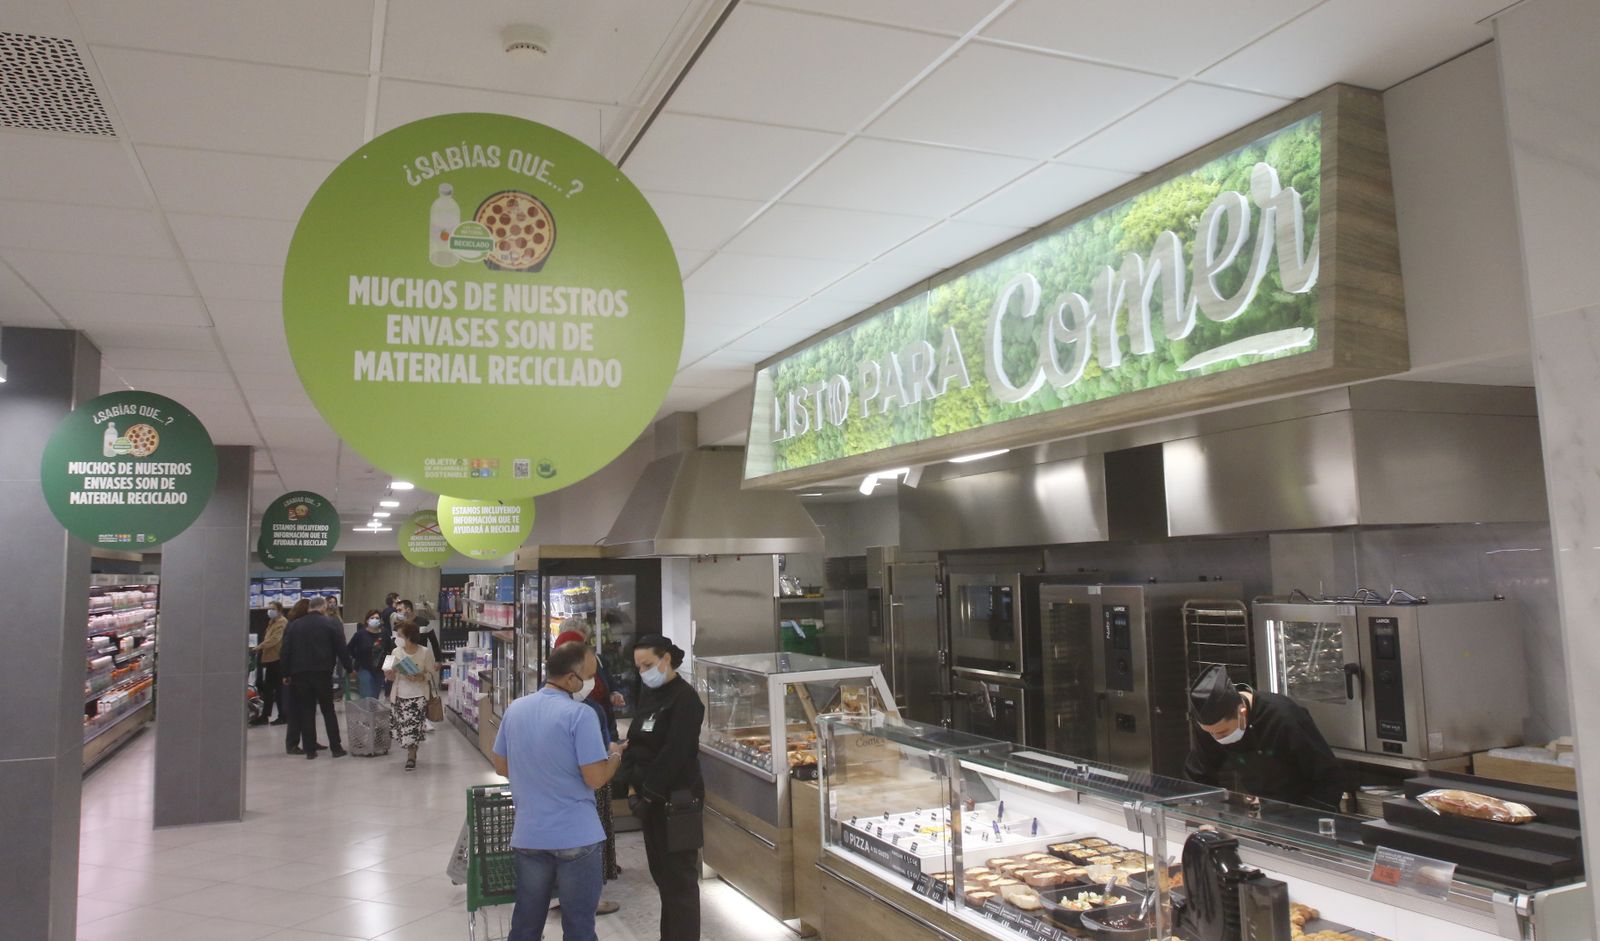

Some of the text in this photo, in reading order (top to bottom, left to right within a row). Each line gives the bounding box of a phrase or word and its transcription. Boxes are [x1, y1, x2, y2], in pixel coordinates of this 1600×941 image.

[403, 141, 500, 186] ¿SABÍAS
[453, 239, 490, 249] RECICLADO
[348, 275, 629, 317] MUCHOS DE NUESTROS
[771, 162, 1321, 443] LISTO PARA Comer
[386, 314, 593, 351] ENVASES SON DE
[353, 351, 622, 388] MATERIAL RECICLADO
[92, 403, 137, 425] ¿SABÍAS
[68, 462, 192, 475] MUCHOS DE NUESTROS
[84, 477, 176, 490] ENVASES SON DE
[70, 491, 188, 505] MATERIAL RECICLADO
[452, 506, 521, 515] ESTAMOS INCLUYENDO
[453, 515, 520, 524] INFORMACIÓN QUE TE
[273, 531, 310, 539] INFORMACIÓN
[453, 524, 520, 534] AYUDARÁ A RECICLAR
[273, 538, 298, 546] AYUDARÁ
[849, 832, 870, 853] PIZZA
